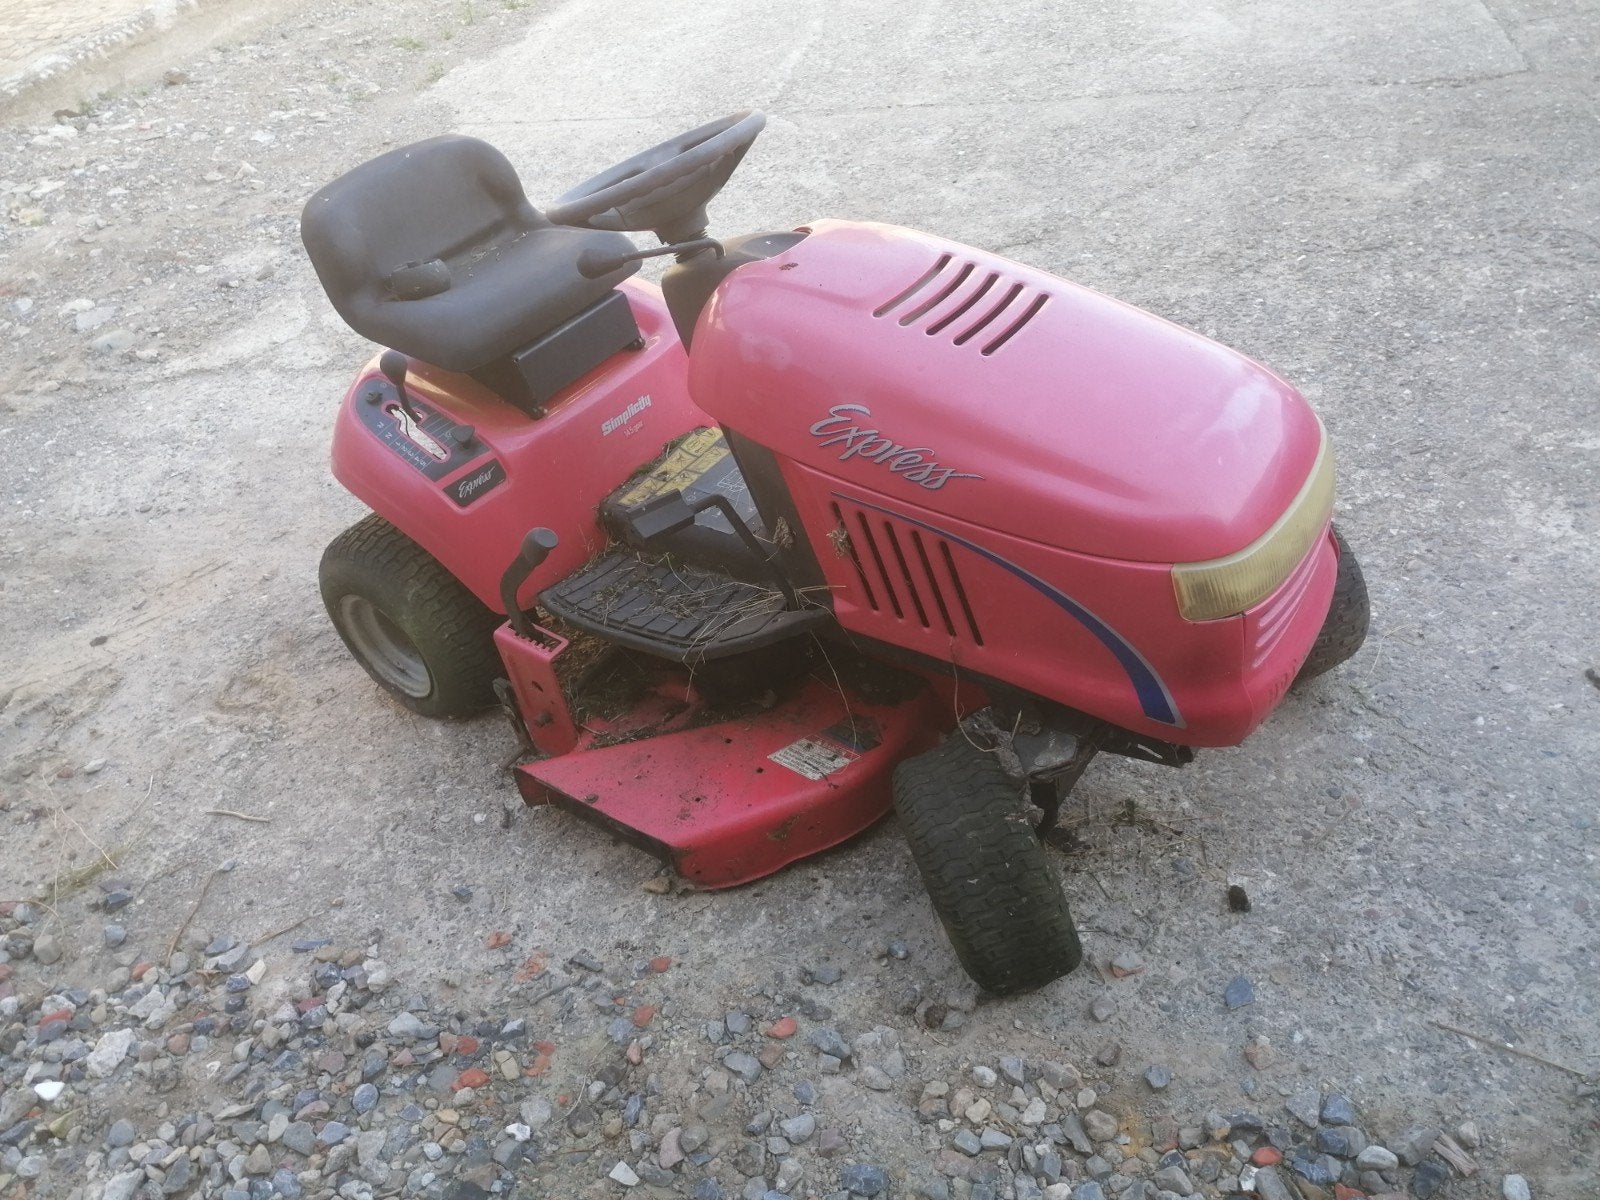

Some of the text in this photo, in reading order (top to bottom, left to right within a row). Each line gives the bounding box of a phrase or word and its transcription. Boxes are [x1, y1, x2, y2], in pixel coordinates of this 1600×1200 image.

[601, 394, 651, 436] Simplicity
[810, 403, 985, 490] Express
[458, 465, 496, 498] Express
